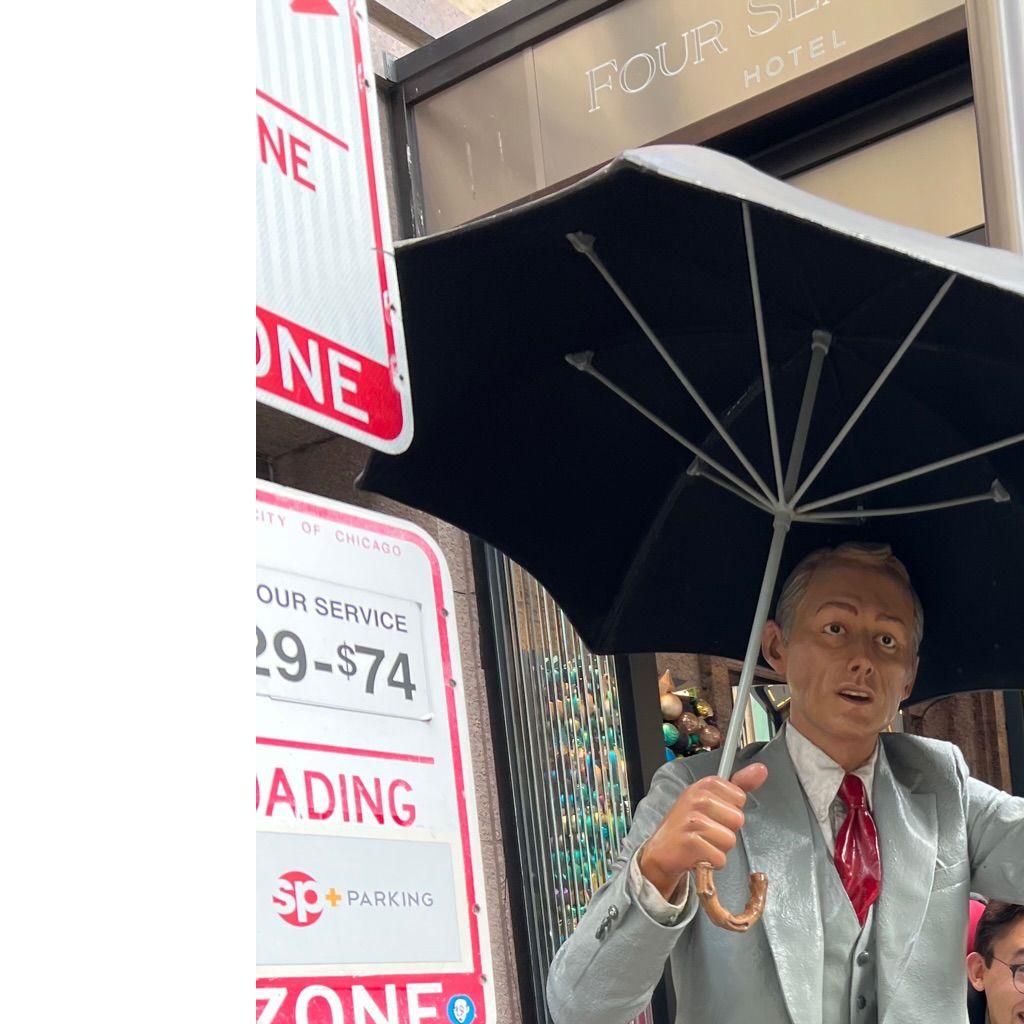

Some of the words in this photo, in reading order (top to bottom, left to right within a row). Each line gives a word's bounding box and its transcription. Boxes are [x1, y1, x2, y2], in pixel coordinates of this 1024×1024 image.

[584, 19, 728, 113] FOUR
[743, 29, 846, 88] HOTEL
[301, 521, 320, 536] OF
[335, 529, 402, 557] CHICAGO
[256, 583, 308, 613] OUR
[315, 597, 408, 633] SERVICE
[256, 767, 417, 827] ADING
[347, 890, 434, 907] PARKING
